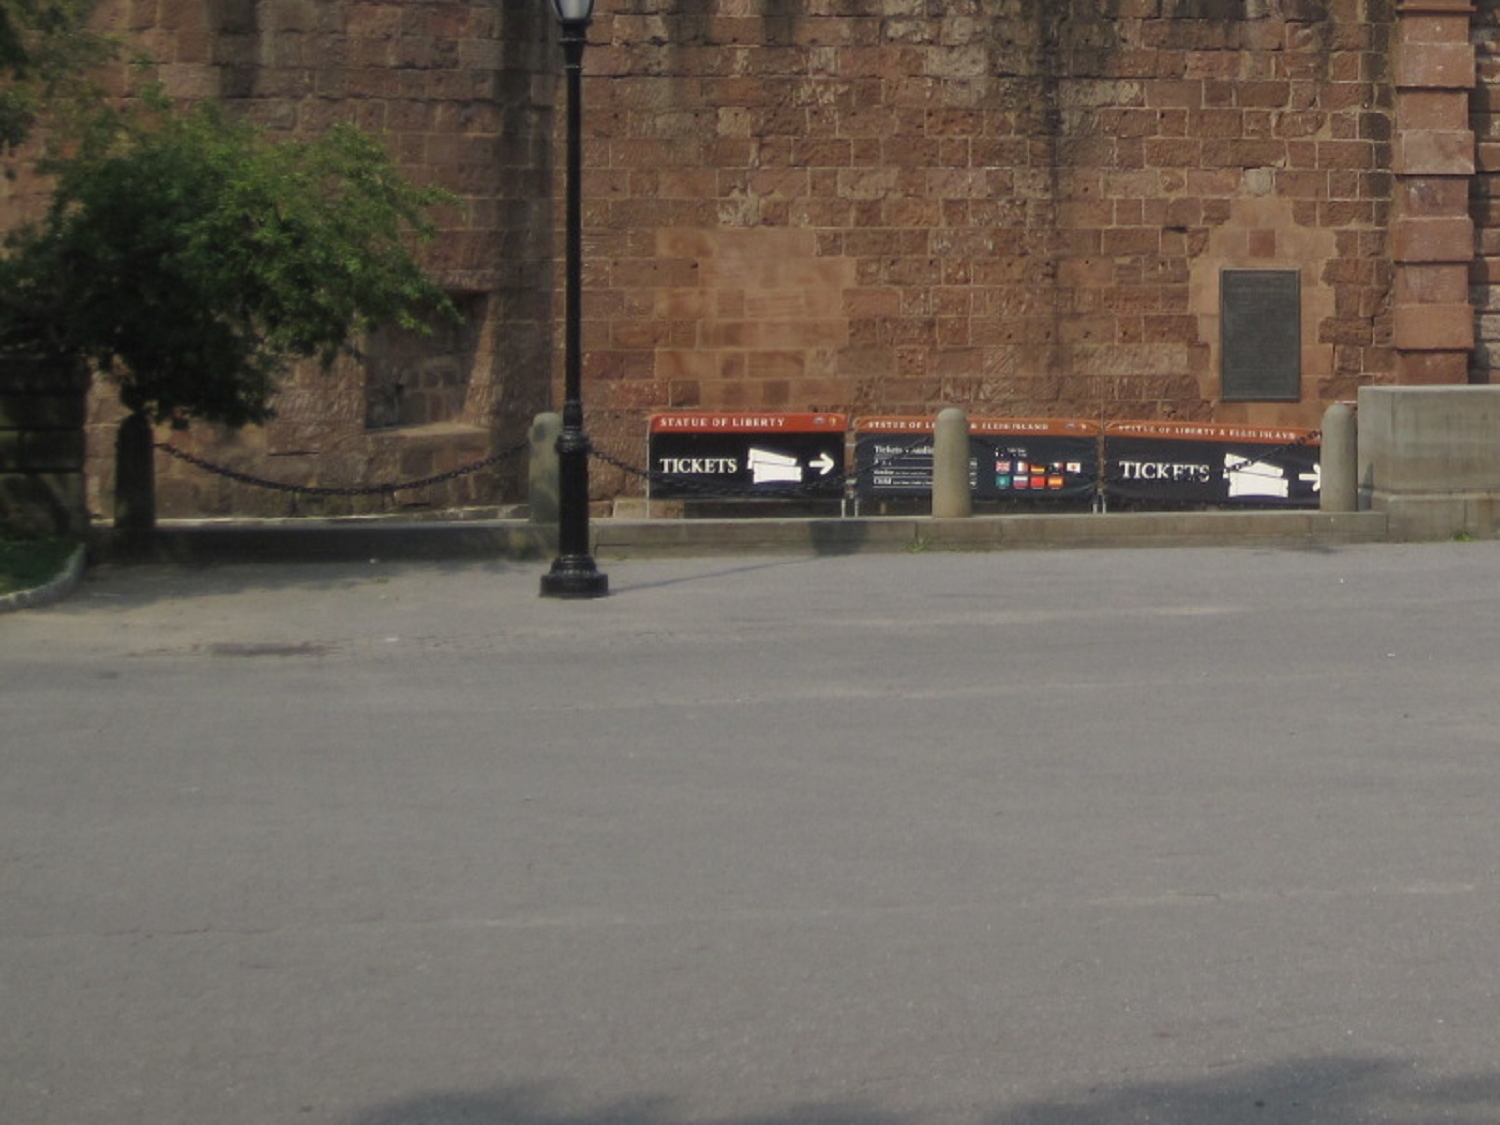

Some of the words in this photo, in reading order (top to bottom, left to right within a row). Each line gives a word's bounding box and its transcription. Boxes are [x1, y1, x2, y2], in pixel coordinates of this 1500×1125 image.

[659, 417, 707, 427] STATUE
[712, 418, 727, 427] OF
[732, 418, 785, 427] LIBERTY
[868, 421, 906, 429] STATUE
[1158, 426, 1171, 434] OF
[1175, 427, 1215, 436] LIBERTY
[658, 457, 738, 474] TICKETS
[1118, 460, 1211, 483] TICKETS
